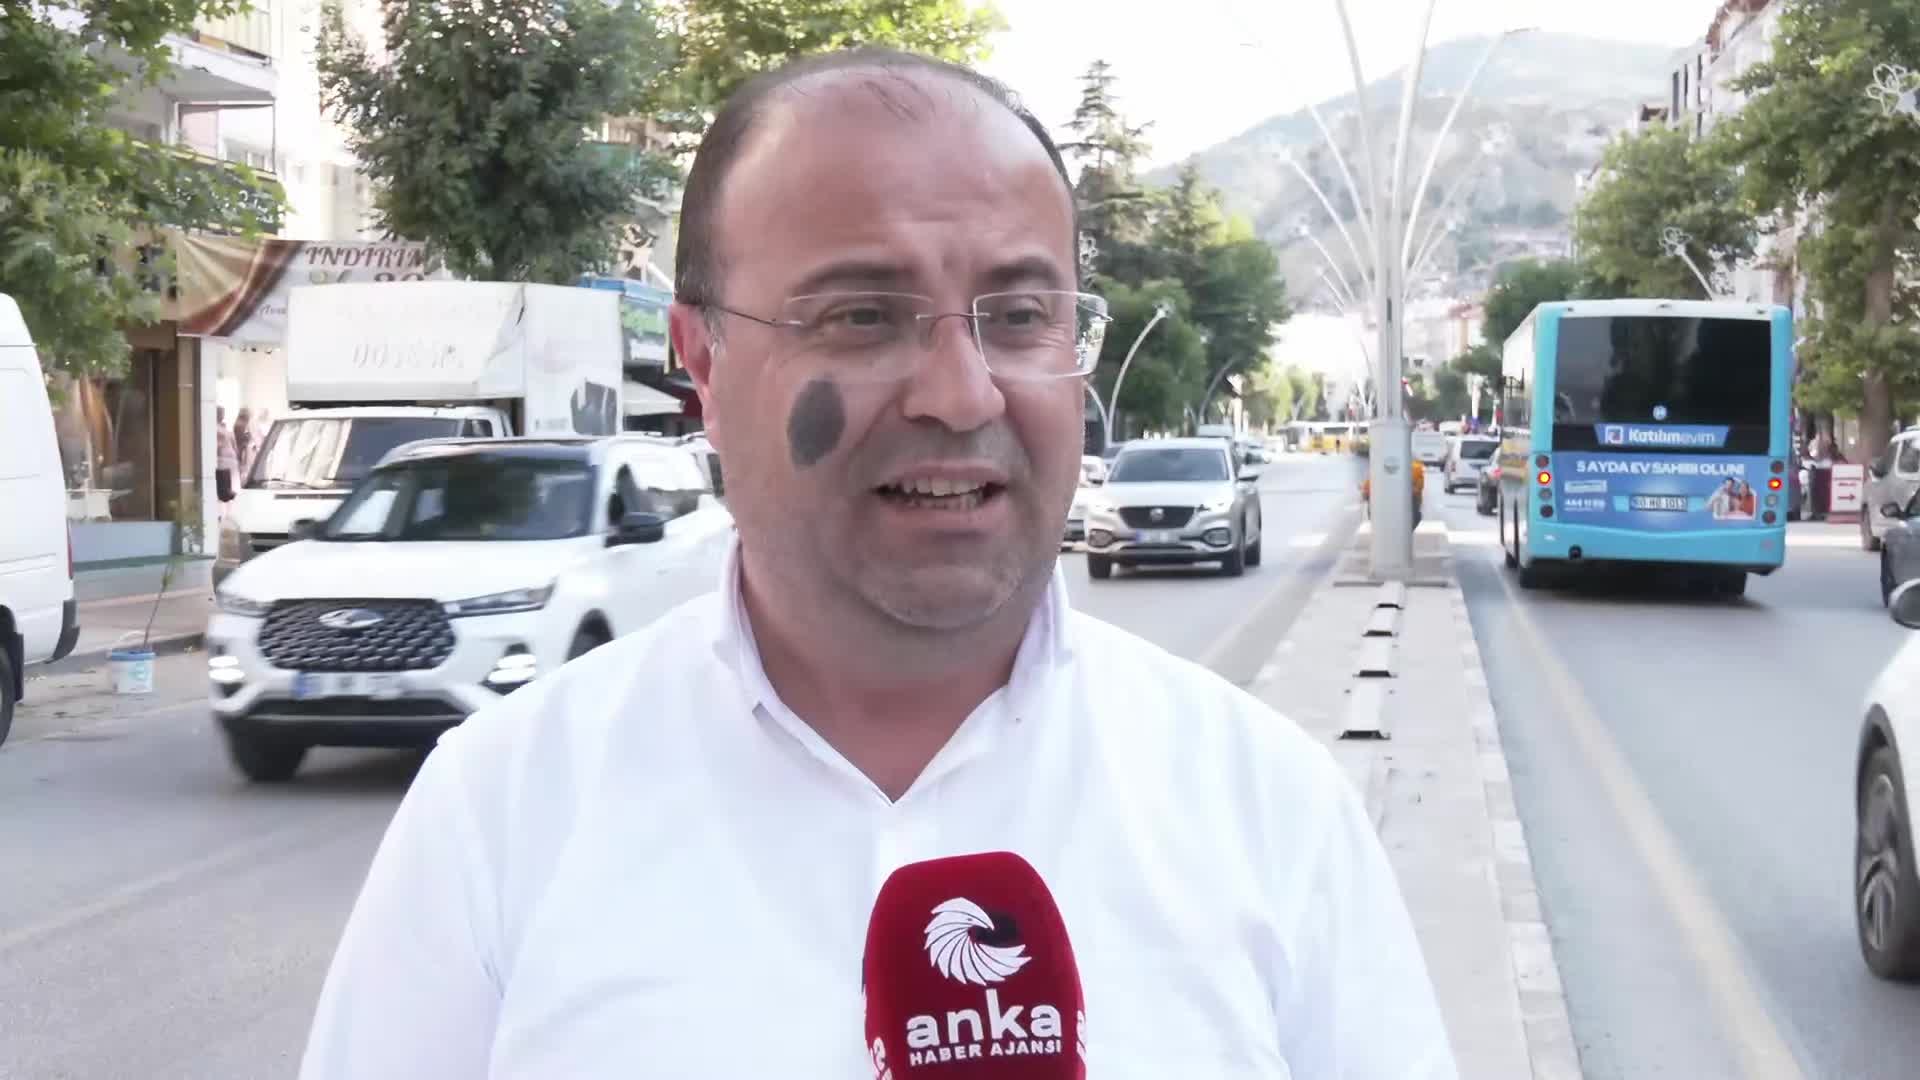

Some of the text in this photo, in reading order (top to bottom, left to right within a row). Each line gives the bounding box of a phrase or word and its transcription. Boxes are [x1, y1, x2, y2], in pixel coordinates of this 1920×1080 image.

[906, 988, 1062, 1048] anka
[909, 1043, 983, 1067] HABER
[990, 1039, 1062, 1056] AJANSI
